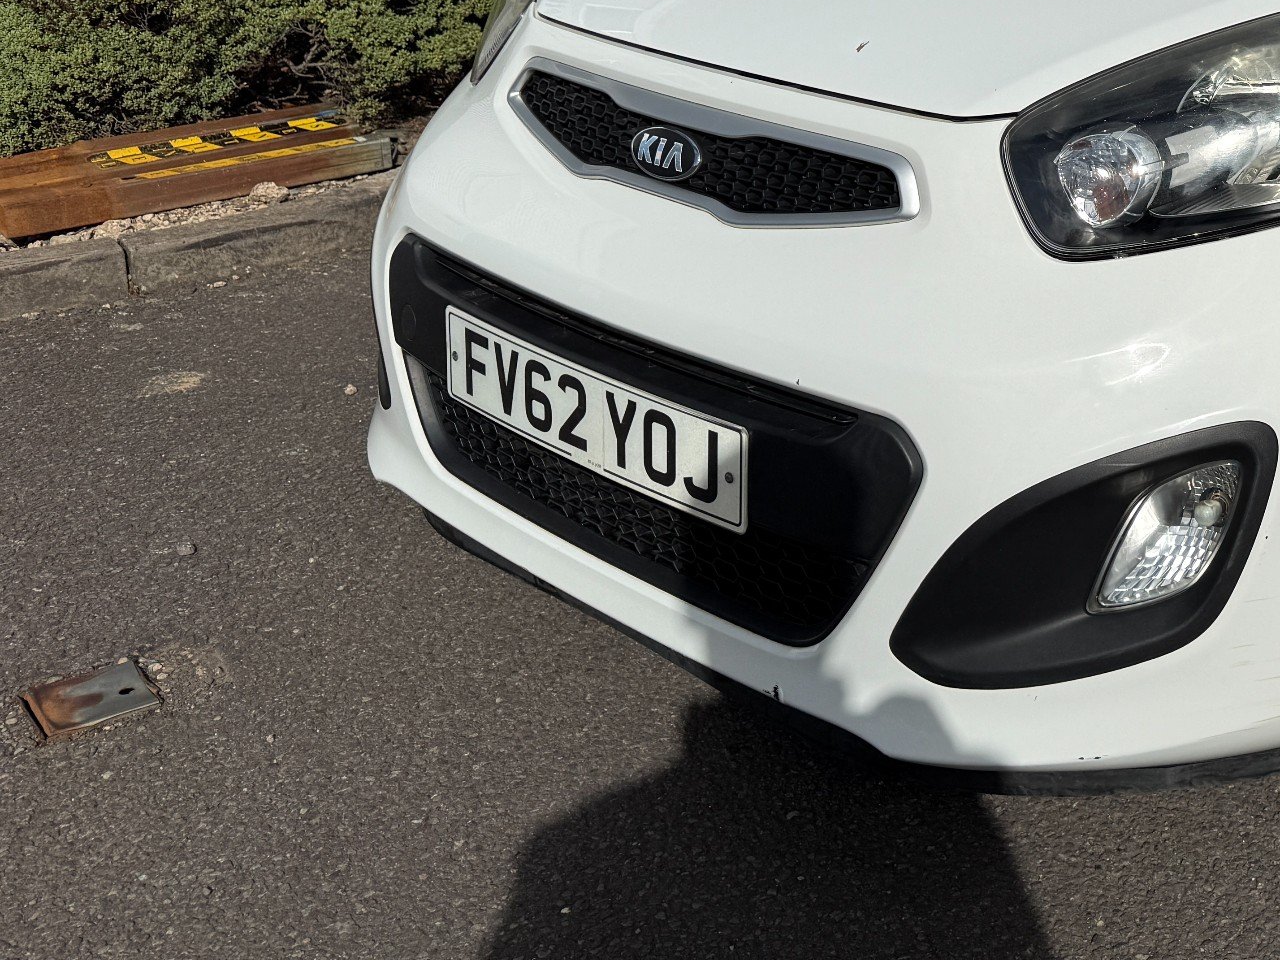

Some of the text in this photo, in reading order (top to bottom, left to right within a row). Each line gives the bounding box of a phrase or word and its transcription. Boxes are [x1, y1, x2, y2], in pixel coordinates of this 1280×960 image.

[637, 132, 684, 172] KIA
[464, 326, 719, 504] FV62 YOJ
